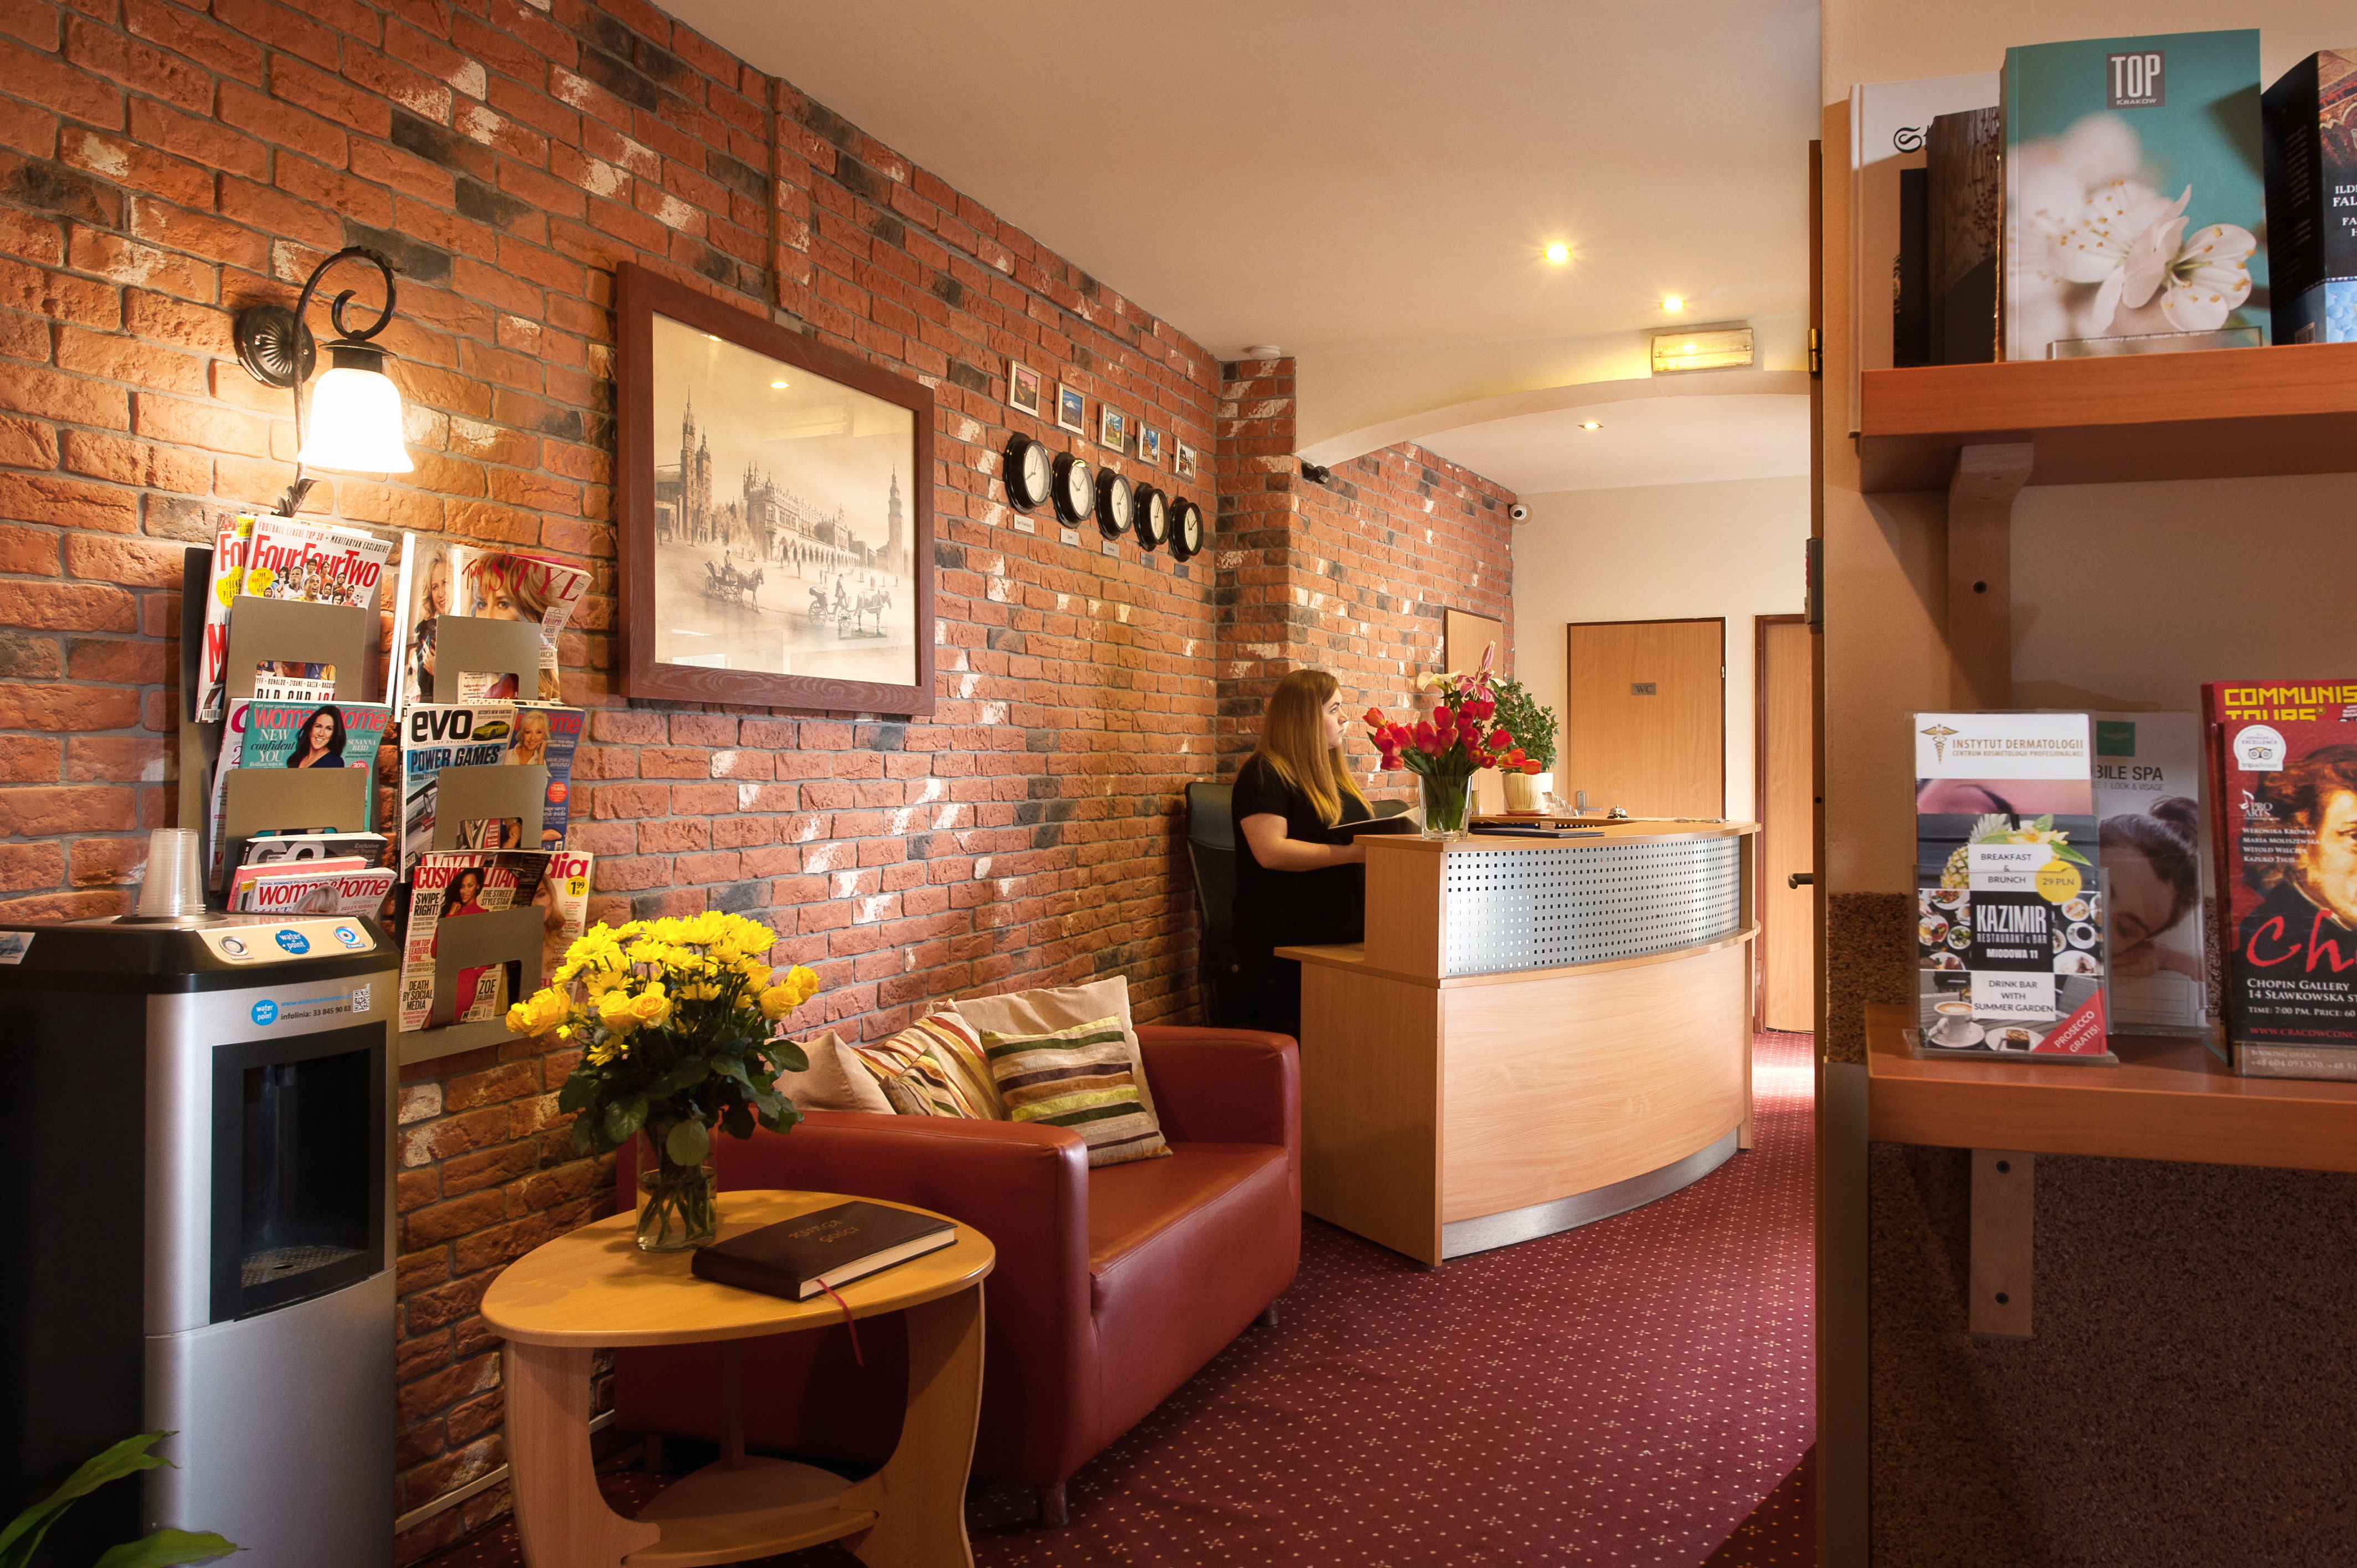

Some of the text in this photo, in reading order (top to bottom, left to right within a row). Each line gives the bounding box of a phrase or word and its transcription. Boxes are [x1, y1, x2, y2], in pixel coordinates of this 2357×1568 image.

[2111, 54, 2160, 98] TOP
[258, 522, 284, 534] FOOTBALL
[286, 527, 305, 538] LEAGUE
[306, 530, 316, 539] TOP
[1636, 685, 1653, 693] WC
[411, 710, 473, 742] evo
[260, 729, 291, 741] NEW
[251, 740, 295, 752] confident
[1953, 740, 2083, 749] INSTYTUT DERMATOLOGII
[260, 750, 285, 762] YOU
[411, 746, 501, 772] POWER GAMES
[2132, 766, 2163, 781] SPA
[415, 893, 440, 904] SWIPE
[493, 889, 513, 898] STREET
[414, 904, 439, 916] RIGHT!
[1977, 905, 2047, 933] KAZIMIR
[1977, 933, 2024, 943] RESTAURANT
[2032, 934, 2047, 944] BAR
[287, 941, 306, 950] point
[1987, 948, 2038, 959] MIODOWA 11
[409, 980, 429, 991] DEATH
[478, 979, 497, 994] ZOE
[2247, 978, 2350, 991] CHOPIN GALLERY
[403, 989, 433, 1002] BY SOCIAL
[2248, 990, 2262, 998] 14
[406, 1000, 425, 1010] MEDIA
[258, 1013, 272, 1021] point
[281, 1011, 311, 1020] infolinia:
[2054, 1010, 2095, 1048] PROSECCO
[2069, 1025, 2101, 1053] GRATIS!
